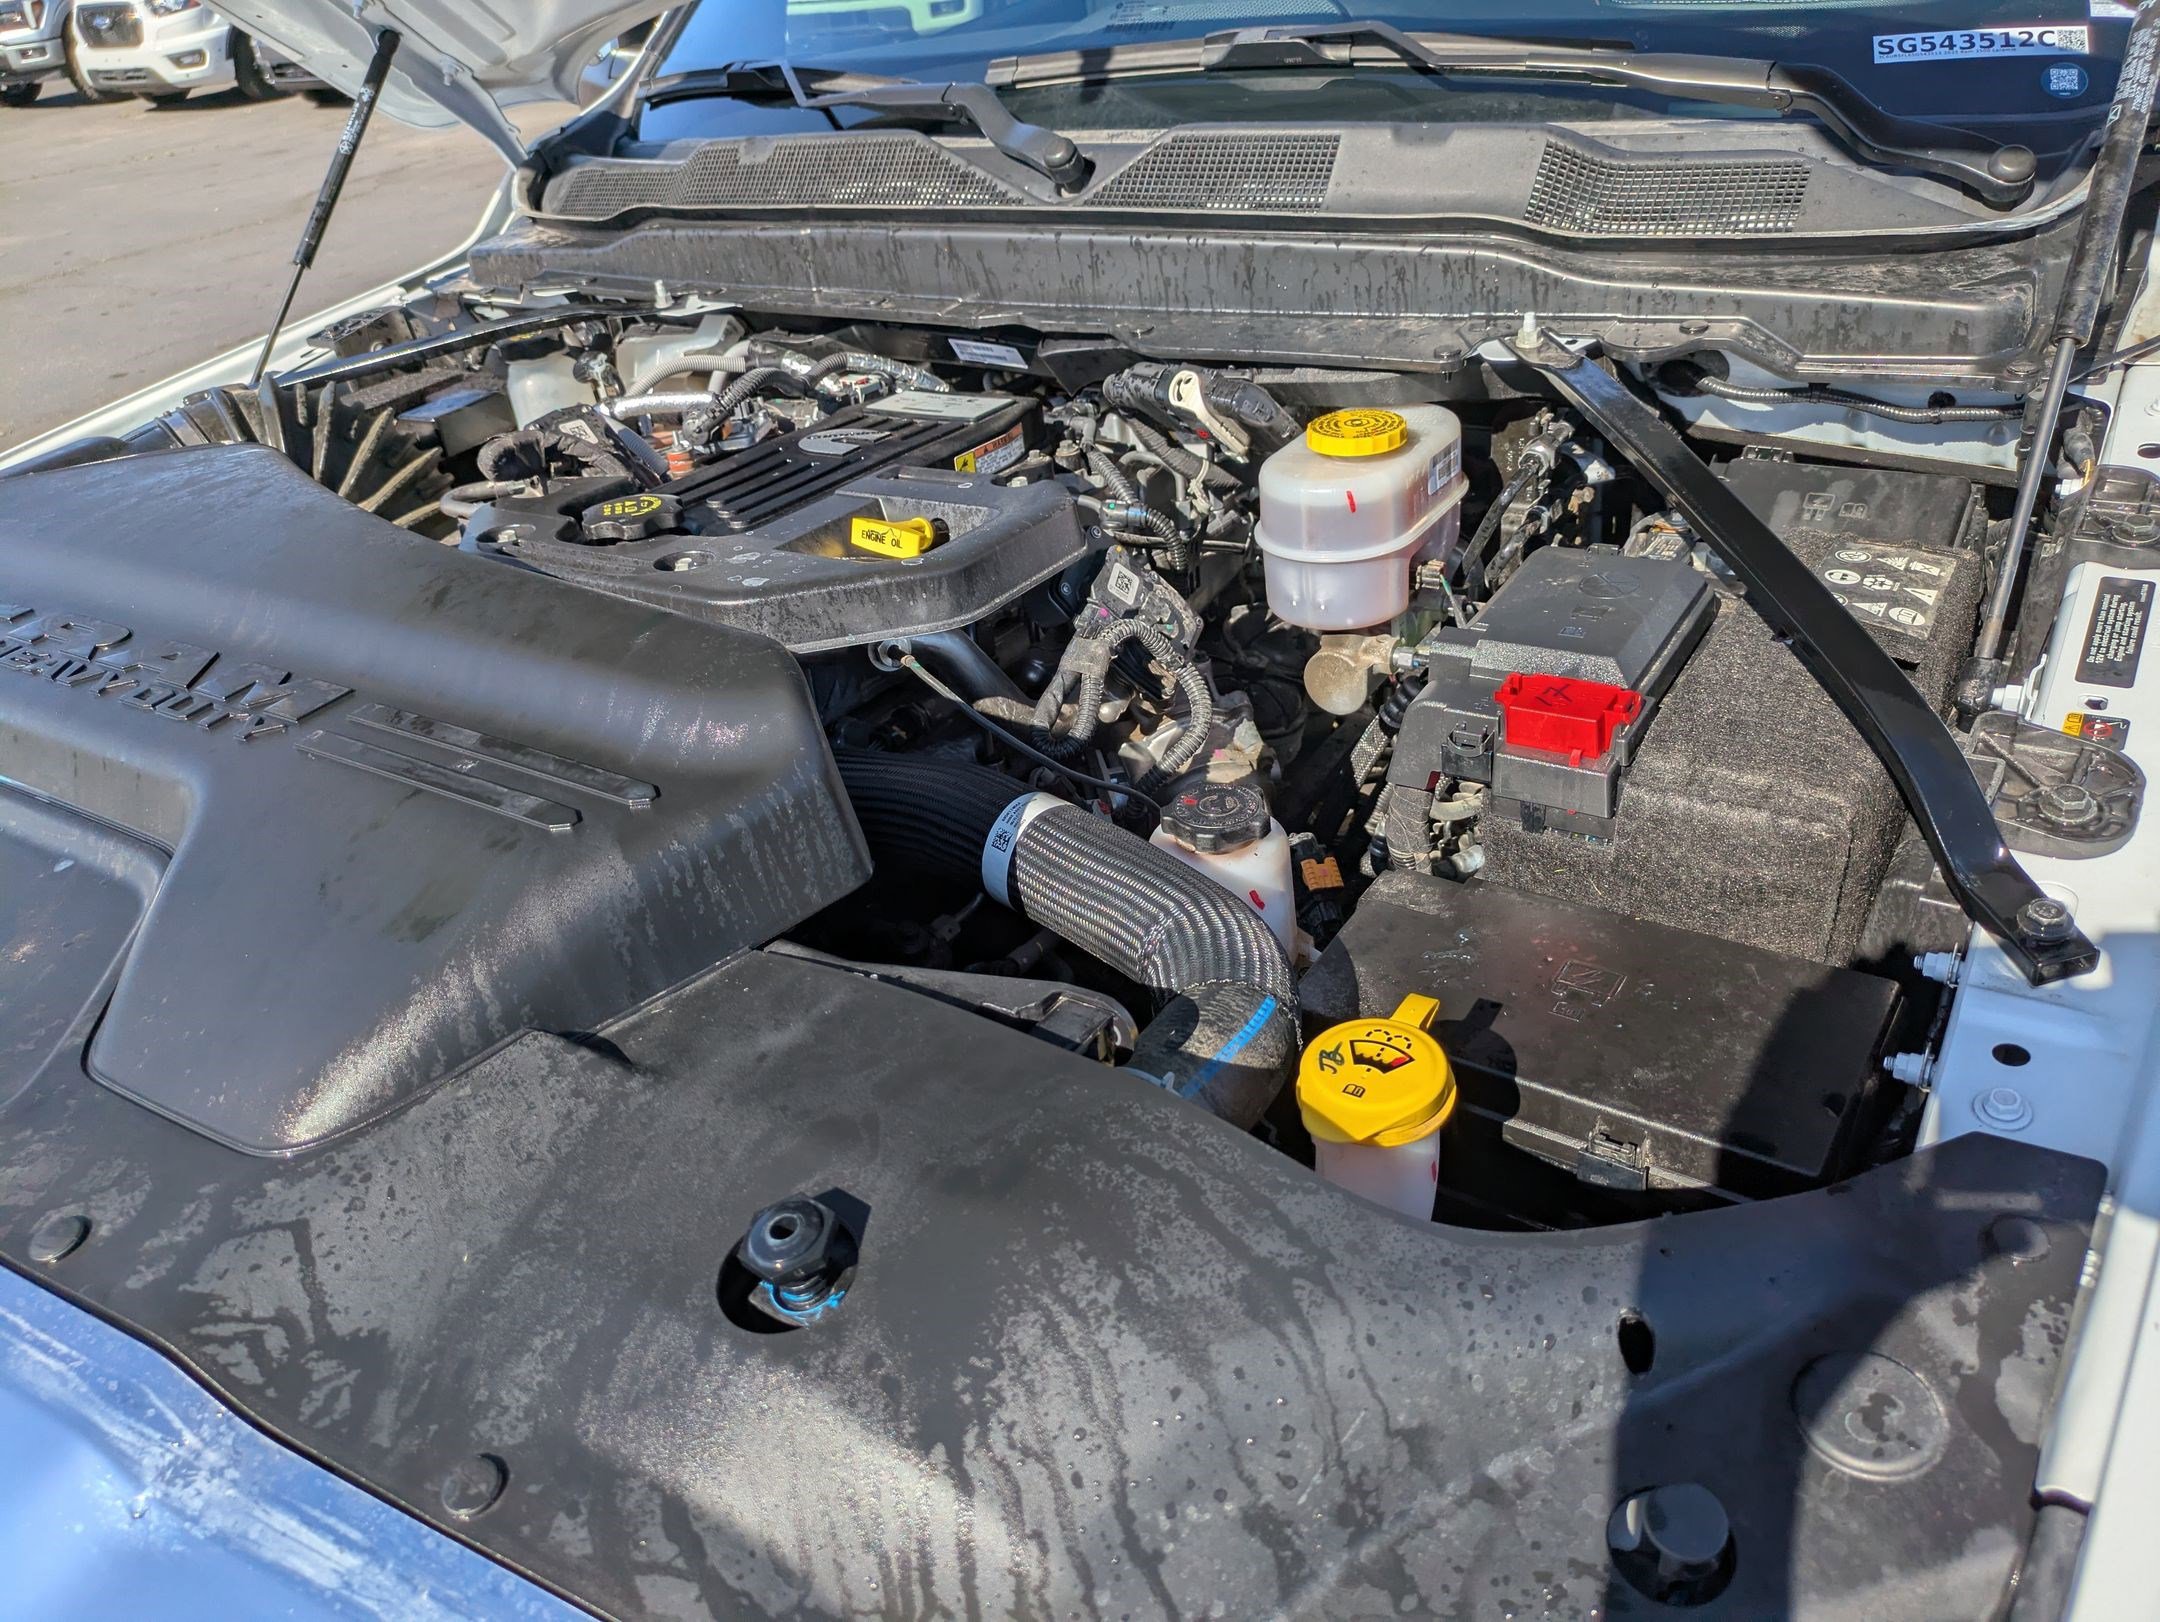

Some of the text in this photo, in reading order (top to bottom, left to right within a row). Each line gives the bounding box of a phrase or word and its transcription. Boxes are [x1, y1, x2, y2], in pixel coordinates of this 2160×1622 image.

[1877, 30, 2056, 55] SG543512C
[861, 529, 903, 549] ENGINE OIL
[6, 612, 356, 724] RAM
